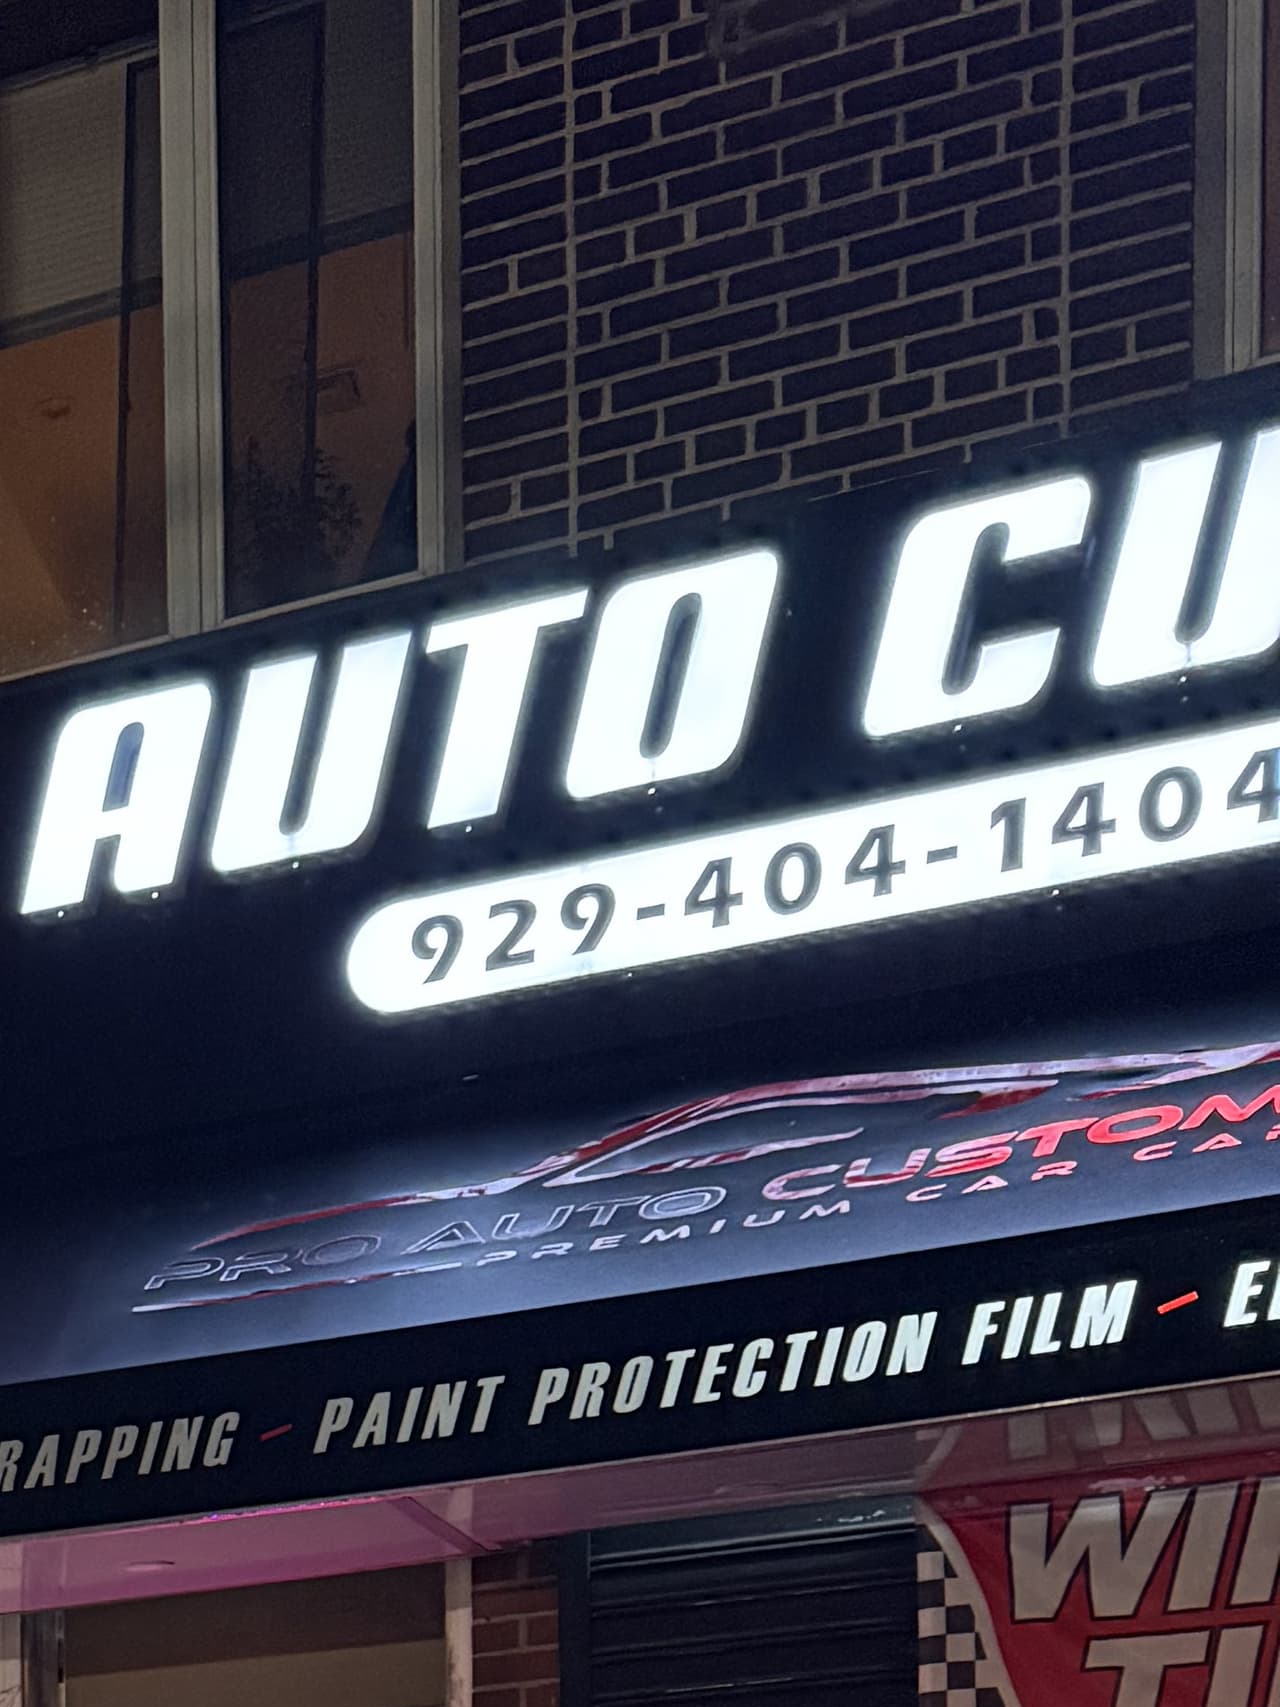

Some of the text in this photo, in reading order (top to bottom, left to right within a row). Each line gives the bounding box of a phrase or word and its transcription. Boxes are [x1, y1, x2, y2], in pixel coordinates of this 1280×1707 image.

[18, 548, 781, 916] AUTO
[863, 427, 1280, 738] CU
[410, 747, 1280, 984] 929-404-1404
[144, 1235, 381, 1290] PRO
[400, 1186, 728, 1255] AUTO
[476, 1199, 851, 1267] PREMIUM
[906, 1160, 1078, 1202] CAR
[312, 1375, 506, 1454] PAINT
[527, 1310, 938, 1426] PROTECTION
[960, 1280, 1138, 1366] FILM
